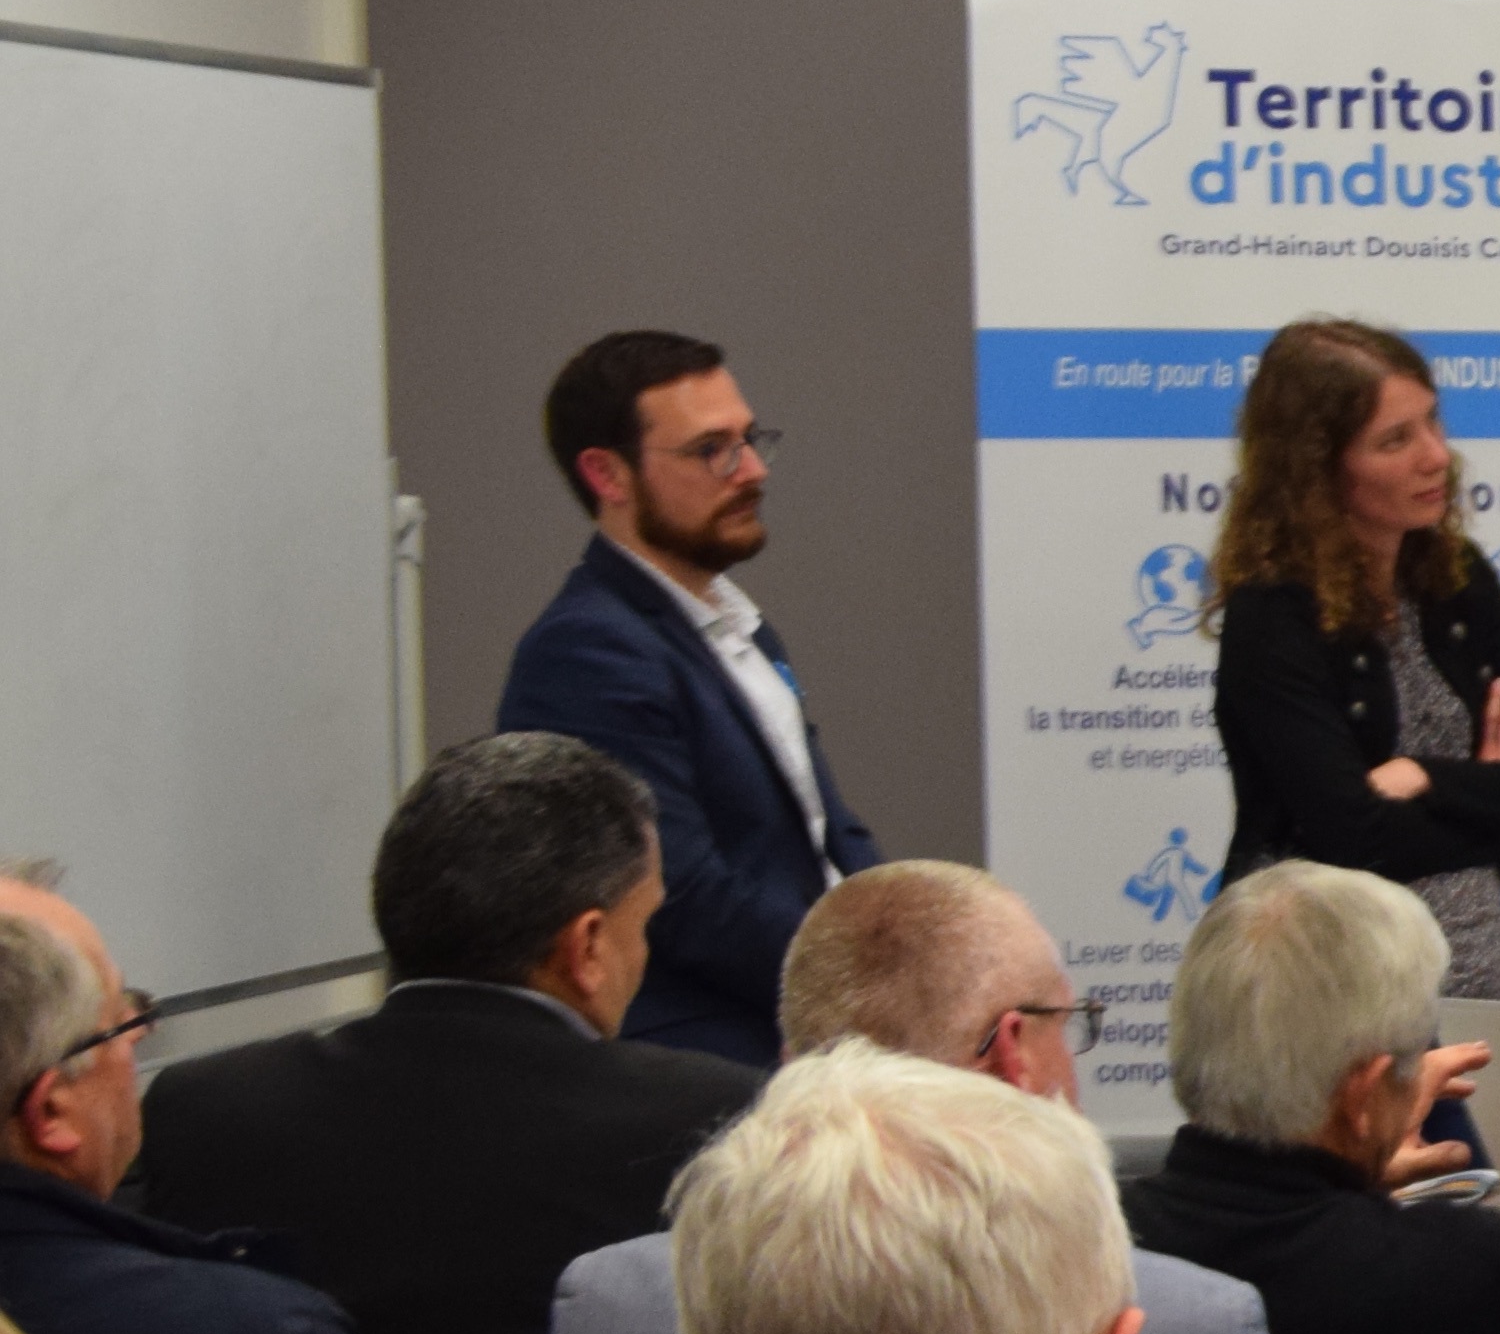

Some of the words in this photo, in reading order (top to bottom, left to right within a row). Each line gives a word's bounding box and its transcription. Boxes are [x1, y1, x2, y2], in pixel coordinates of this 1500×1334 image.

[1161, 233, 1356, 259] Grand-Hainaut
[1366, 235, 1471, 260] Douaisis
[1055, 356, 1087, 388] En
[1096, 358, 1151, 387] route
[1157, 363, 1210, 393] pour
[1213, 358, 1233, 387] la
[1029, 705, 1051, 730] la
[1058, 704, 1180, 729] transition
[1090, 745, 1113, 769] et
[1065, 940, 1132, 965] Lever
[1139, 939, 1184, 963] des
